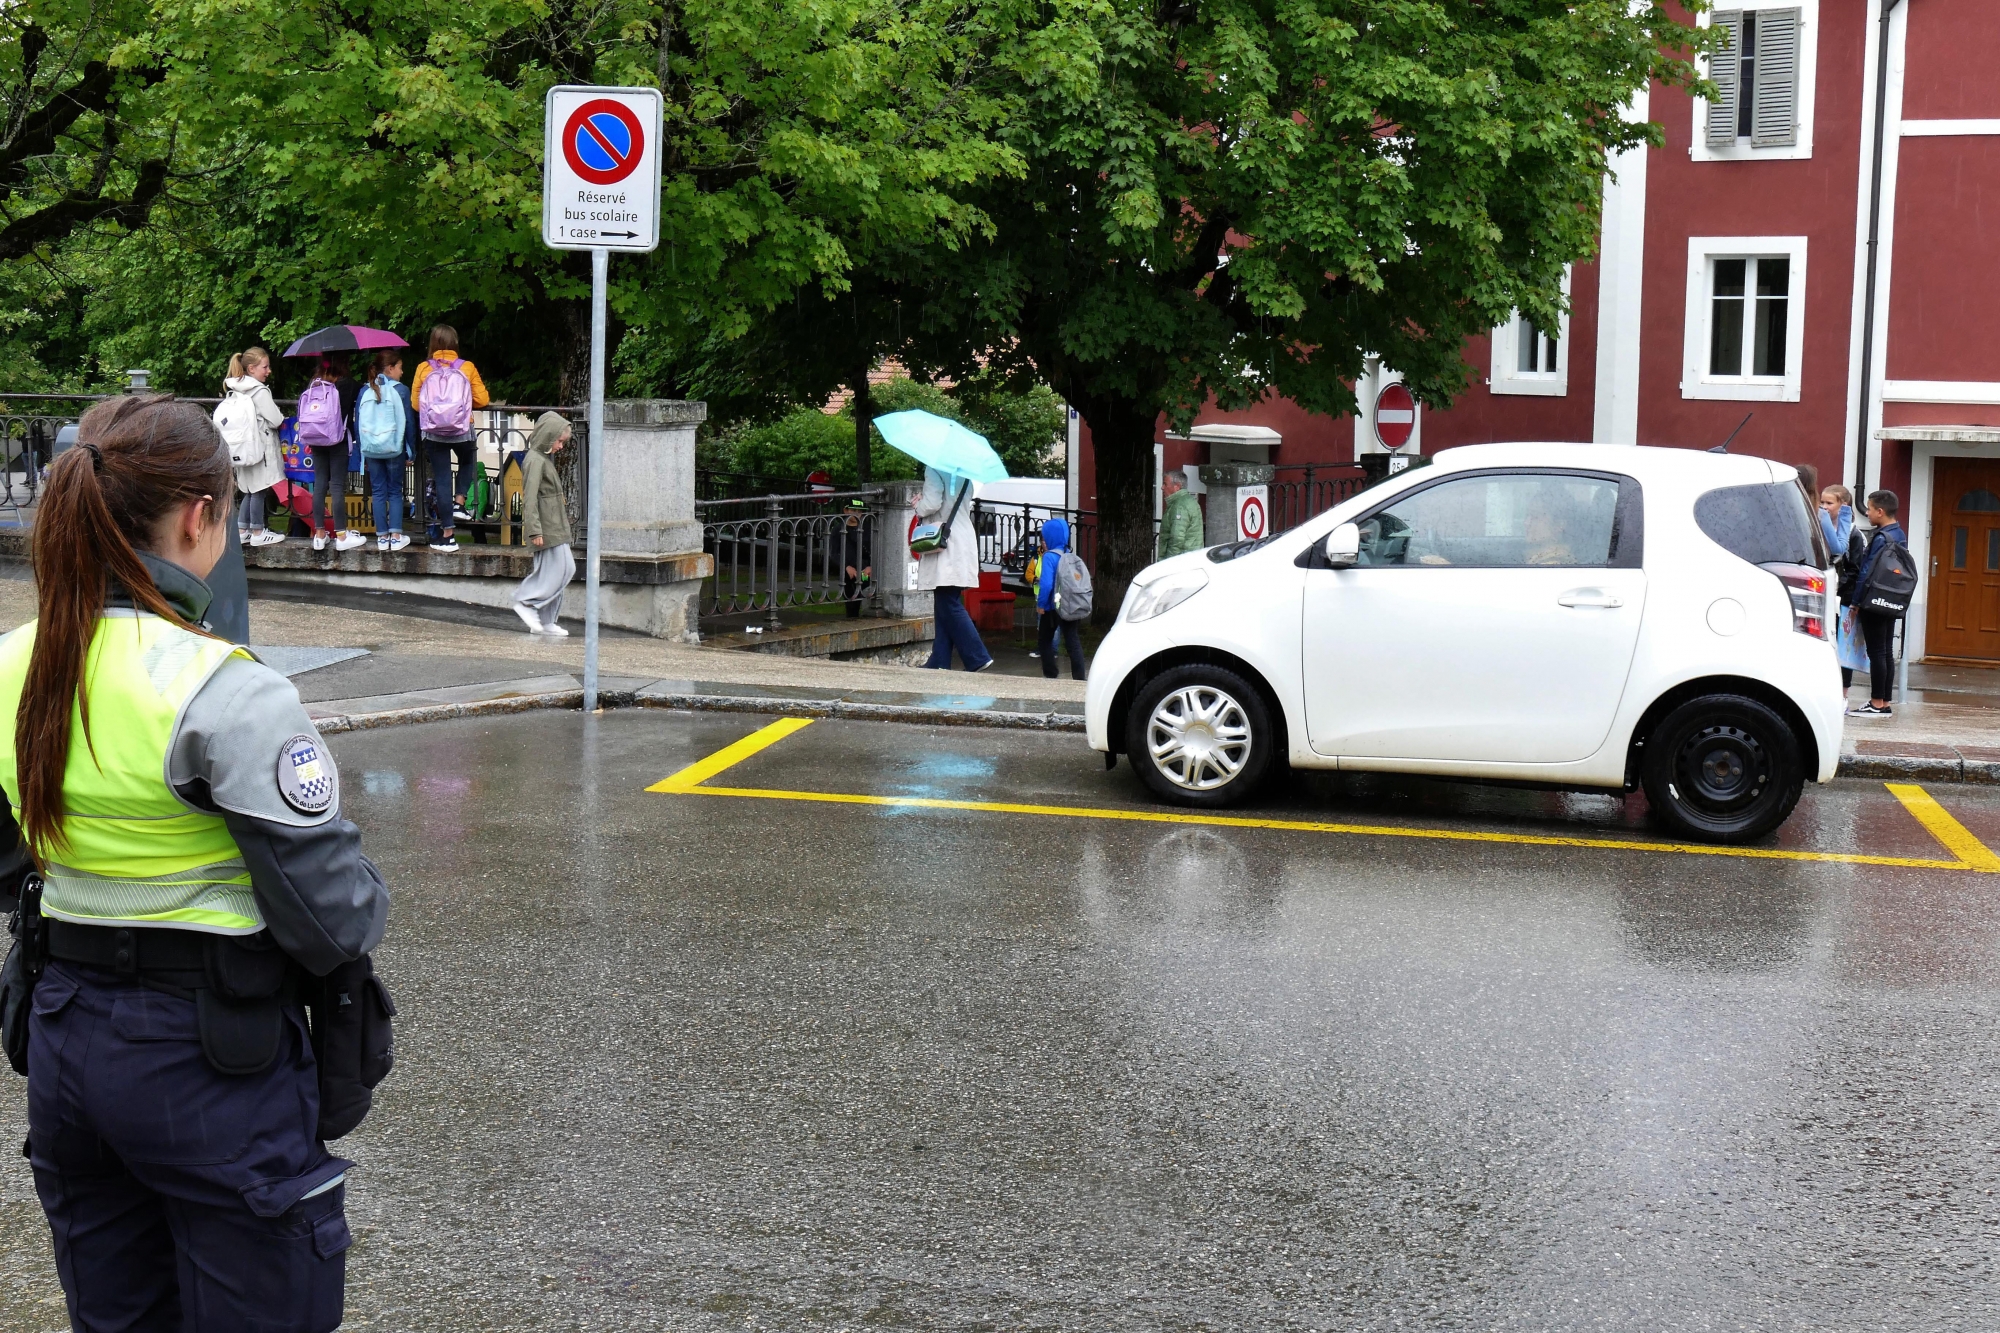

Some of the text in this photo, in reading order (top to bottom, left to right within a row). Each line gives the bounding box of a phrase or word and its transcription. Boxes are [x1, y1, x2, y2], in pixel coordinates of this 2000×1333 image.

[578, 190, 626, 204] Réservé
[564, 207, 638, 222] bus scolaire
[559, 225, 597, 239] 1 case
[1871, 597, 1904, 610] ellesse
[288, 790, 300, 804] Ville
